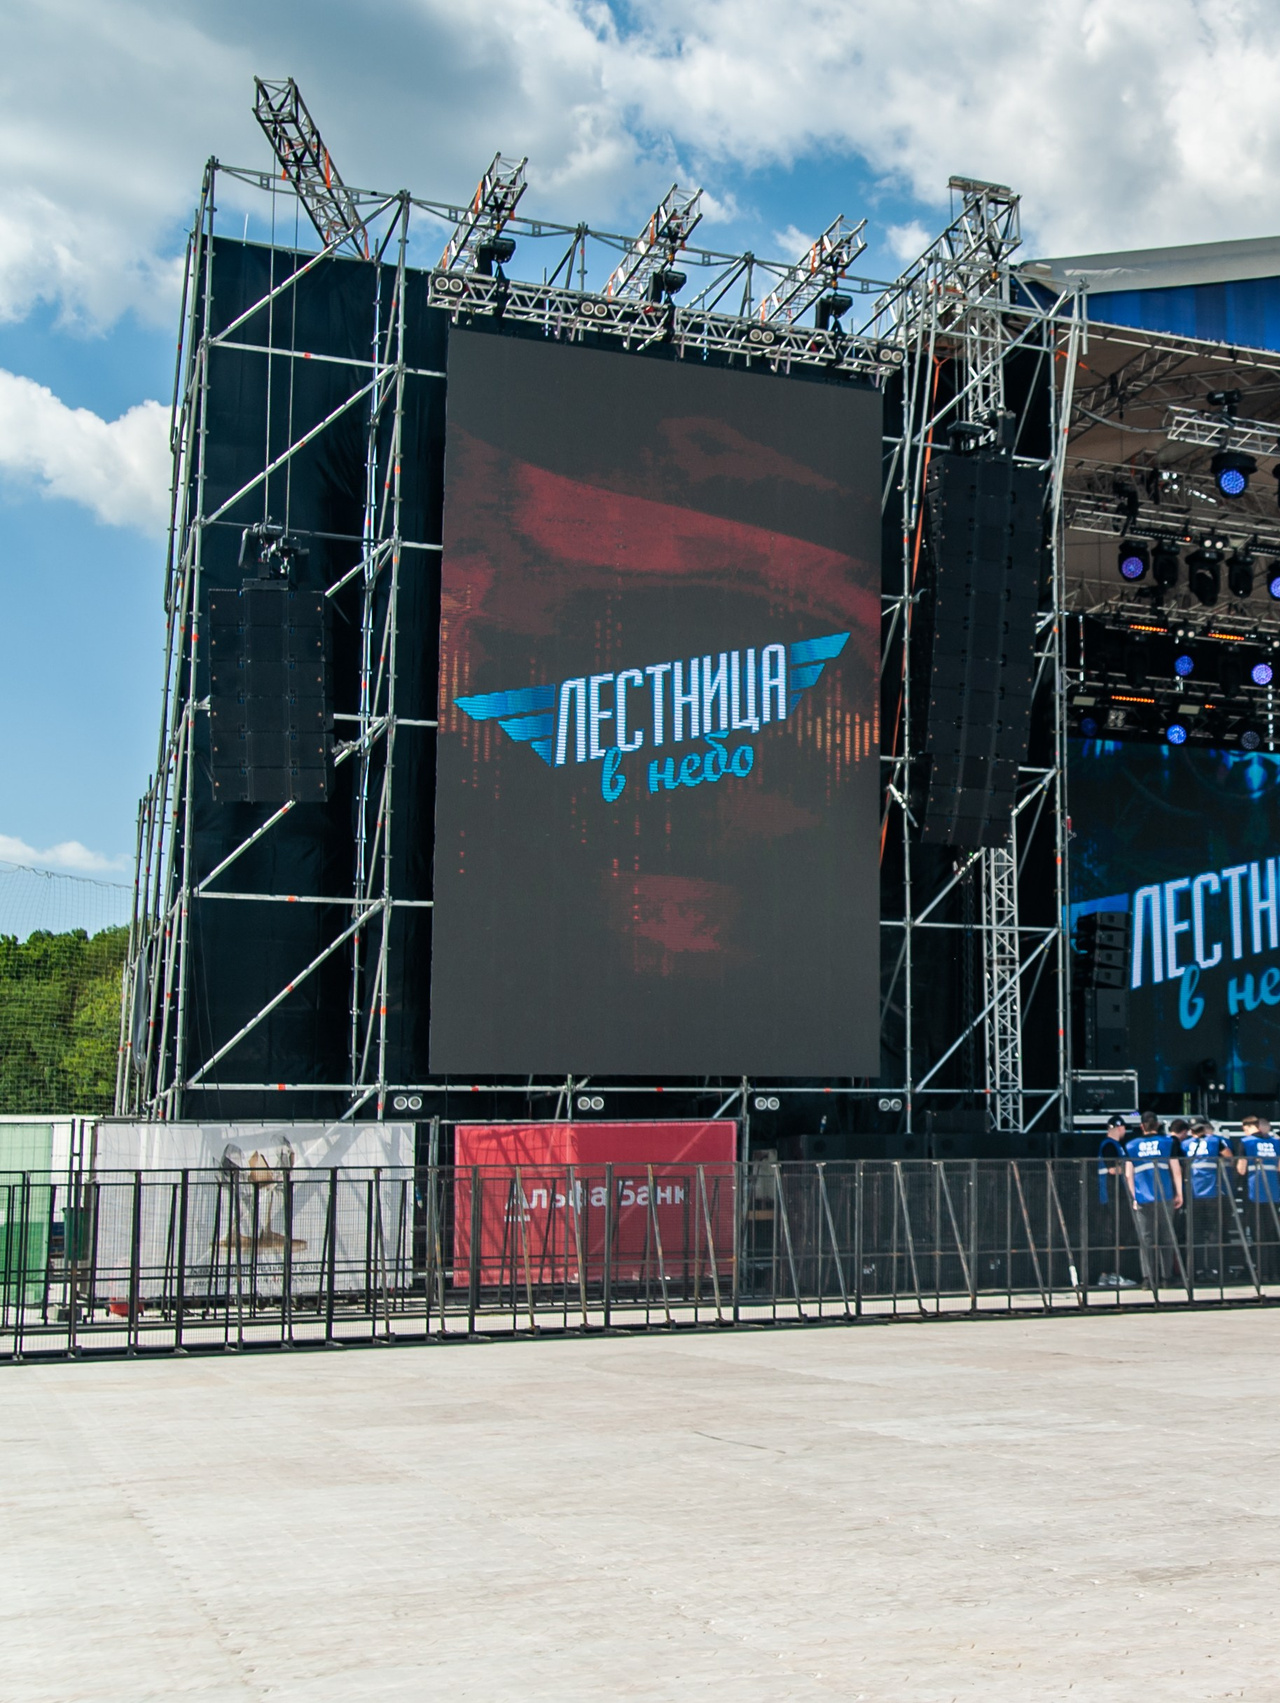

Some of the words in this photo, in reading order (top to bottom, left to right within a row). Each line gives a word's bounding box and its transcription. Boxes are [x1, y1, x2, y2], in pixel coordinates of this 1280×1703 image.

[555, 643, 787, 766] ЛЕСТНИЦА
[601, 746, 627, 802] в
[648, 730, 755, 794] небо
[1178, 965, 1205, 1030] в
